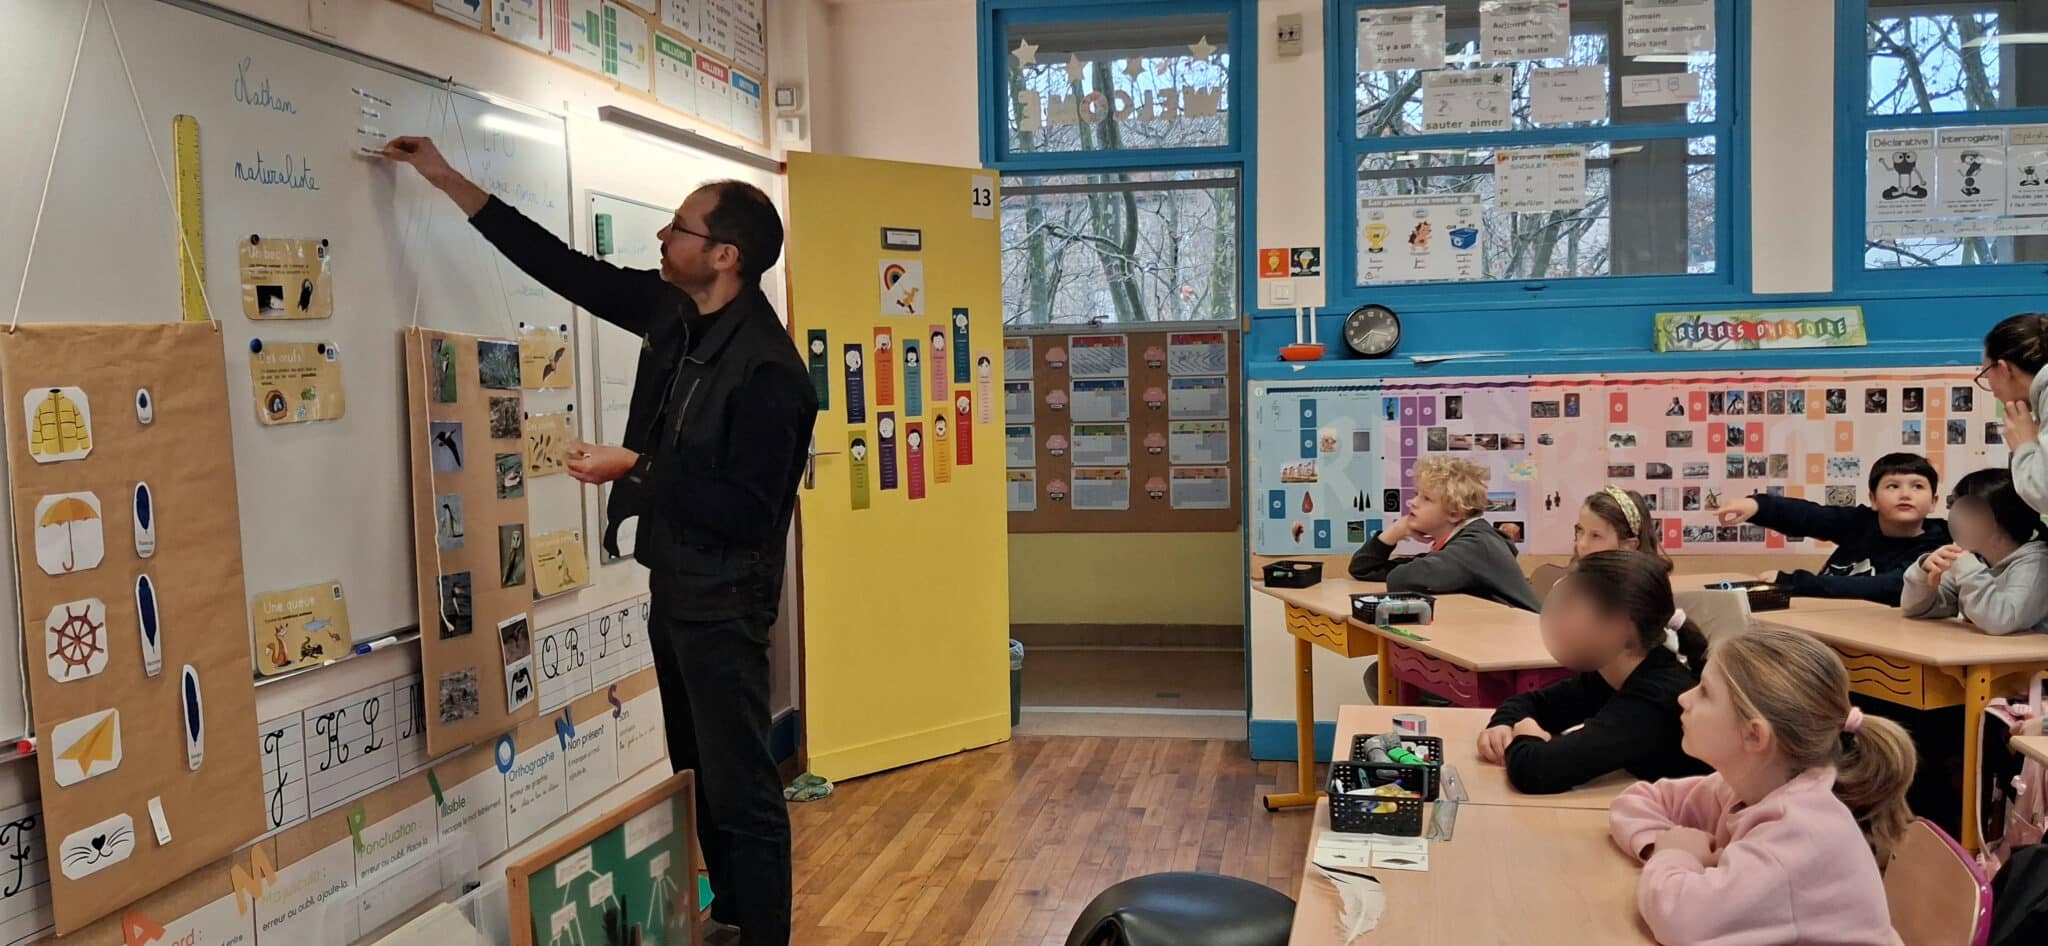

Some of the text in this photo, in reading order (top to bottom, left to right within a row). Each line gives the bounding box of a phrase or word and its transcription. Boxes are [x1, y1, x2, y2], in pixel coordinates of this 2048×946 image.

[234, 56, 297, 115] Nathan
[1425, 117, 1504, 131] sauter aimer
[1941, 134, 2000, 145] Interrogative
[1873, 138, 1929, 149] Déclarative
[234, 151, 321, 191] naturaliste
[971, 187, 992, 208] 13
[1756, 317, 1846, 338] D'HISTOIRE
[263, 599, 283, 615] Une
[541, 627, 586, 680] Q R
[607, 683, 622, 719] S
[315, 696, 384, 771] K L
[554, 704, 575, 753] N
[567, 737, 582, 752] Non
[581, 724, 605, 749] présent
[494, 733, 516, 774] O
[508, 751, 556, 782] Orthographe
[348, 800, 369, 854] P
[230, 843, 279, 917] M
[262, 913, 287, 933] erreur
[286, 907, 298, 919] ou
